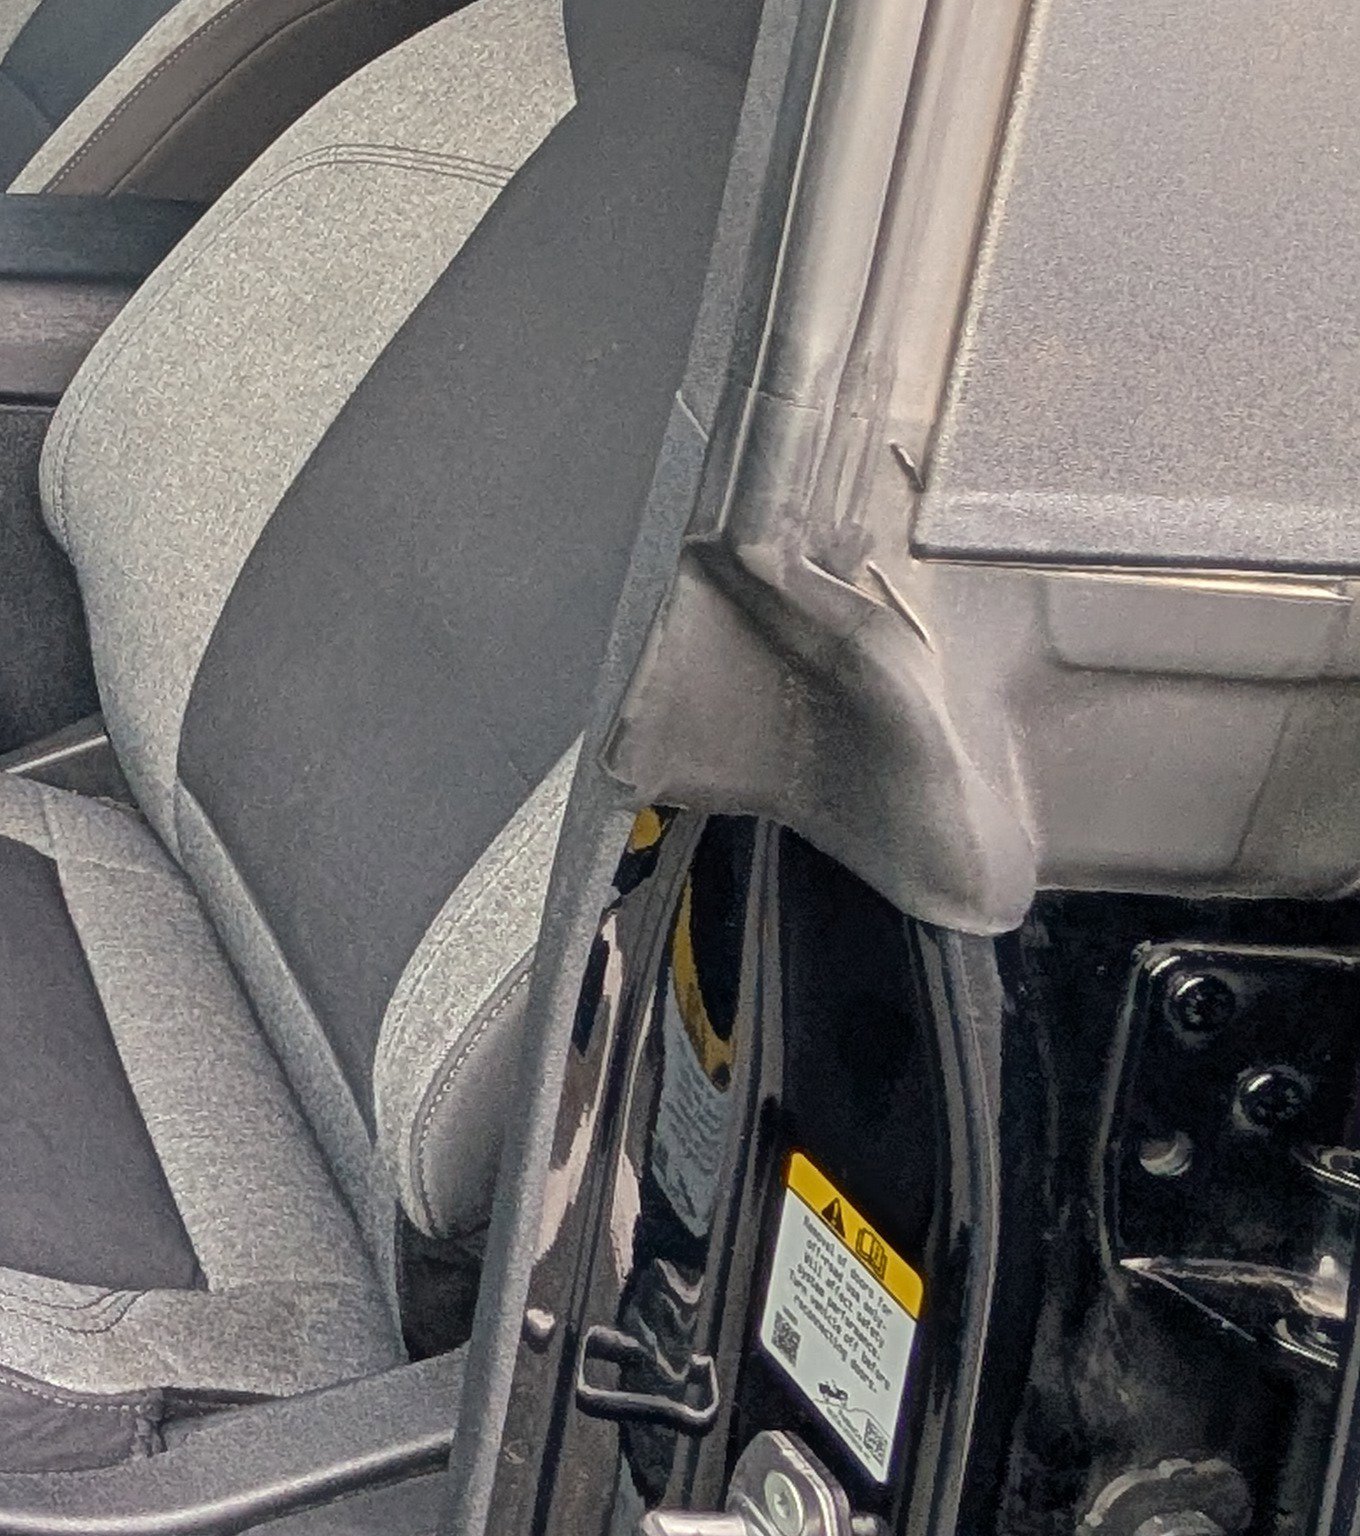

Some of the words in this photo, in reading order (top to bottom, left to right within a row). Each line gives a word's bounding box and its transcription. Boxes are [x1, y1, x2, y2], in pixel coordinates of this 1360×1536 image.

[796, 1262, 825, 1297] system
[802, 1214, 835, 1256] Removal
[836, 1252, 848, 1268] of
[849, 1267, 875, 1299] doors
[876, 1295, 893, 1315] for
[803, 1251, 823, 1279] Will
[824, 1277, 853, 1313] affect
[855, 1310, 885, 1349] safety
[805, 1239, 844, 1283] off-road
[788, 1268, 808, 1295] Turn
[809, 1294, 842, 1335] vehicle
[842, 1332, 859, 1352] off
[860, 1349, 890, 1391] before
[793, 1294, 848, 1361] reconnecting
